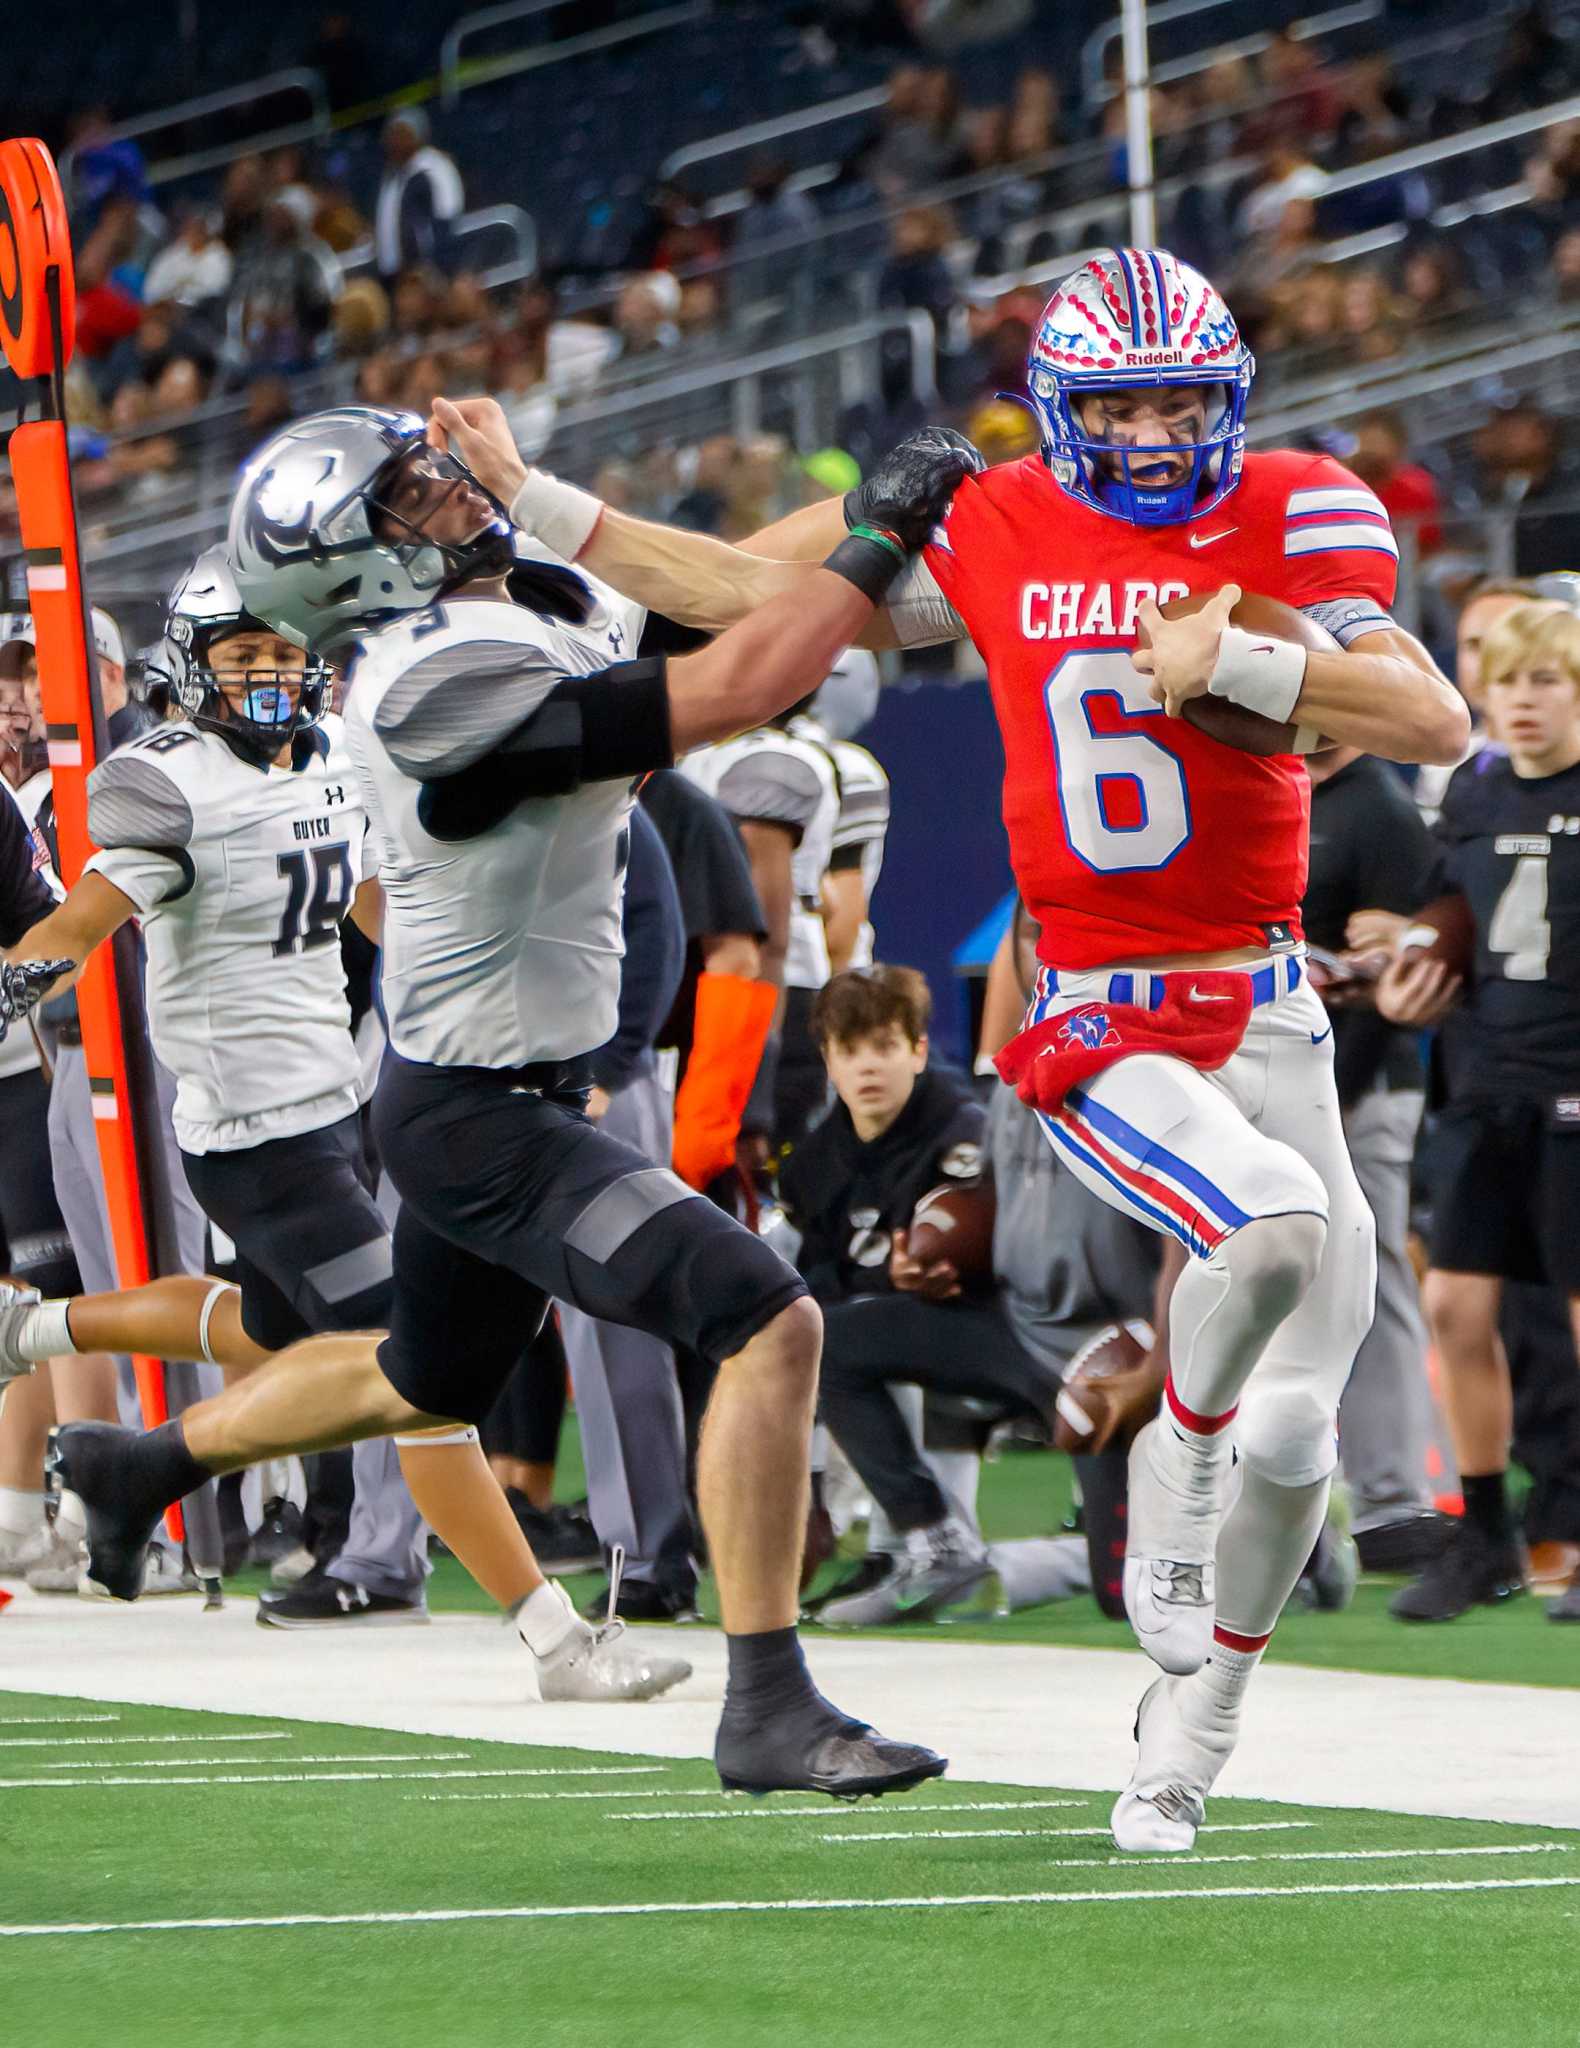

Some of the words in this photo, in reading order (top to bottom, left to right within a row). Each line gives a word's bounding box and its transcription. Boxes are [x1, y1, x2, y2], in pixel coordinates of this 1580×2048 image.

[1126, 351, 1183, 365] Riddell
[1042, 648, 1193, 876] 6
[1488, 855, 1550, 981] 4
